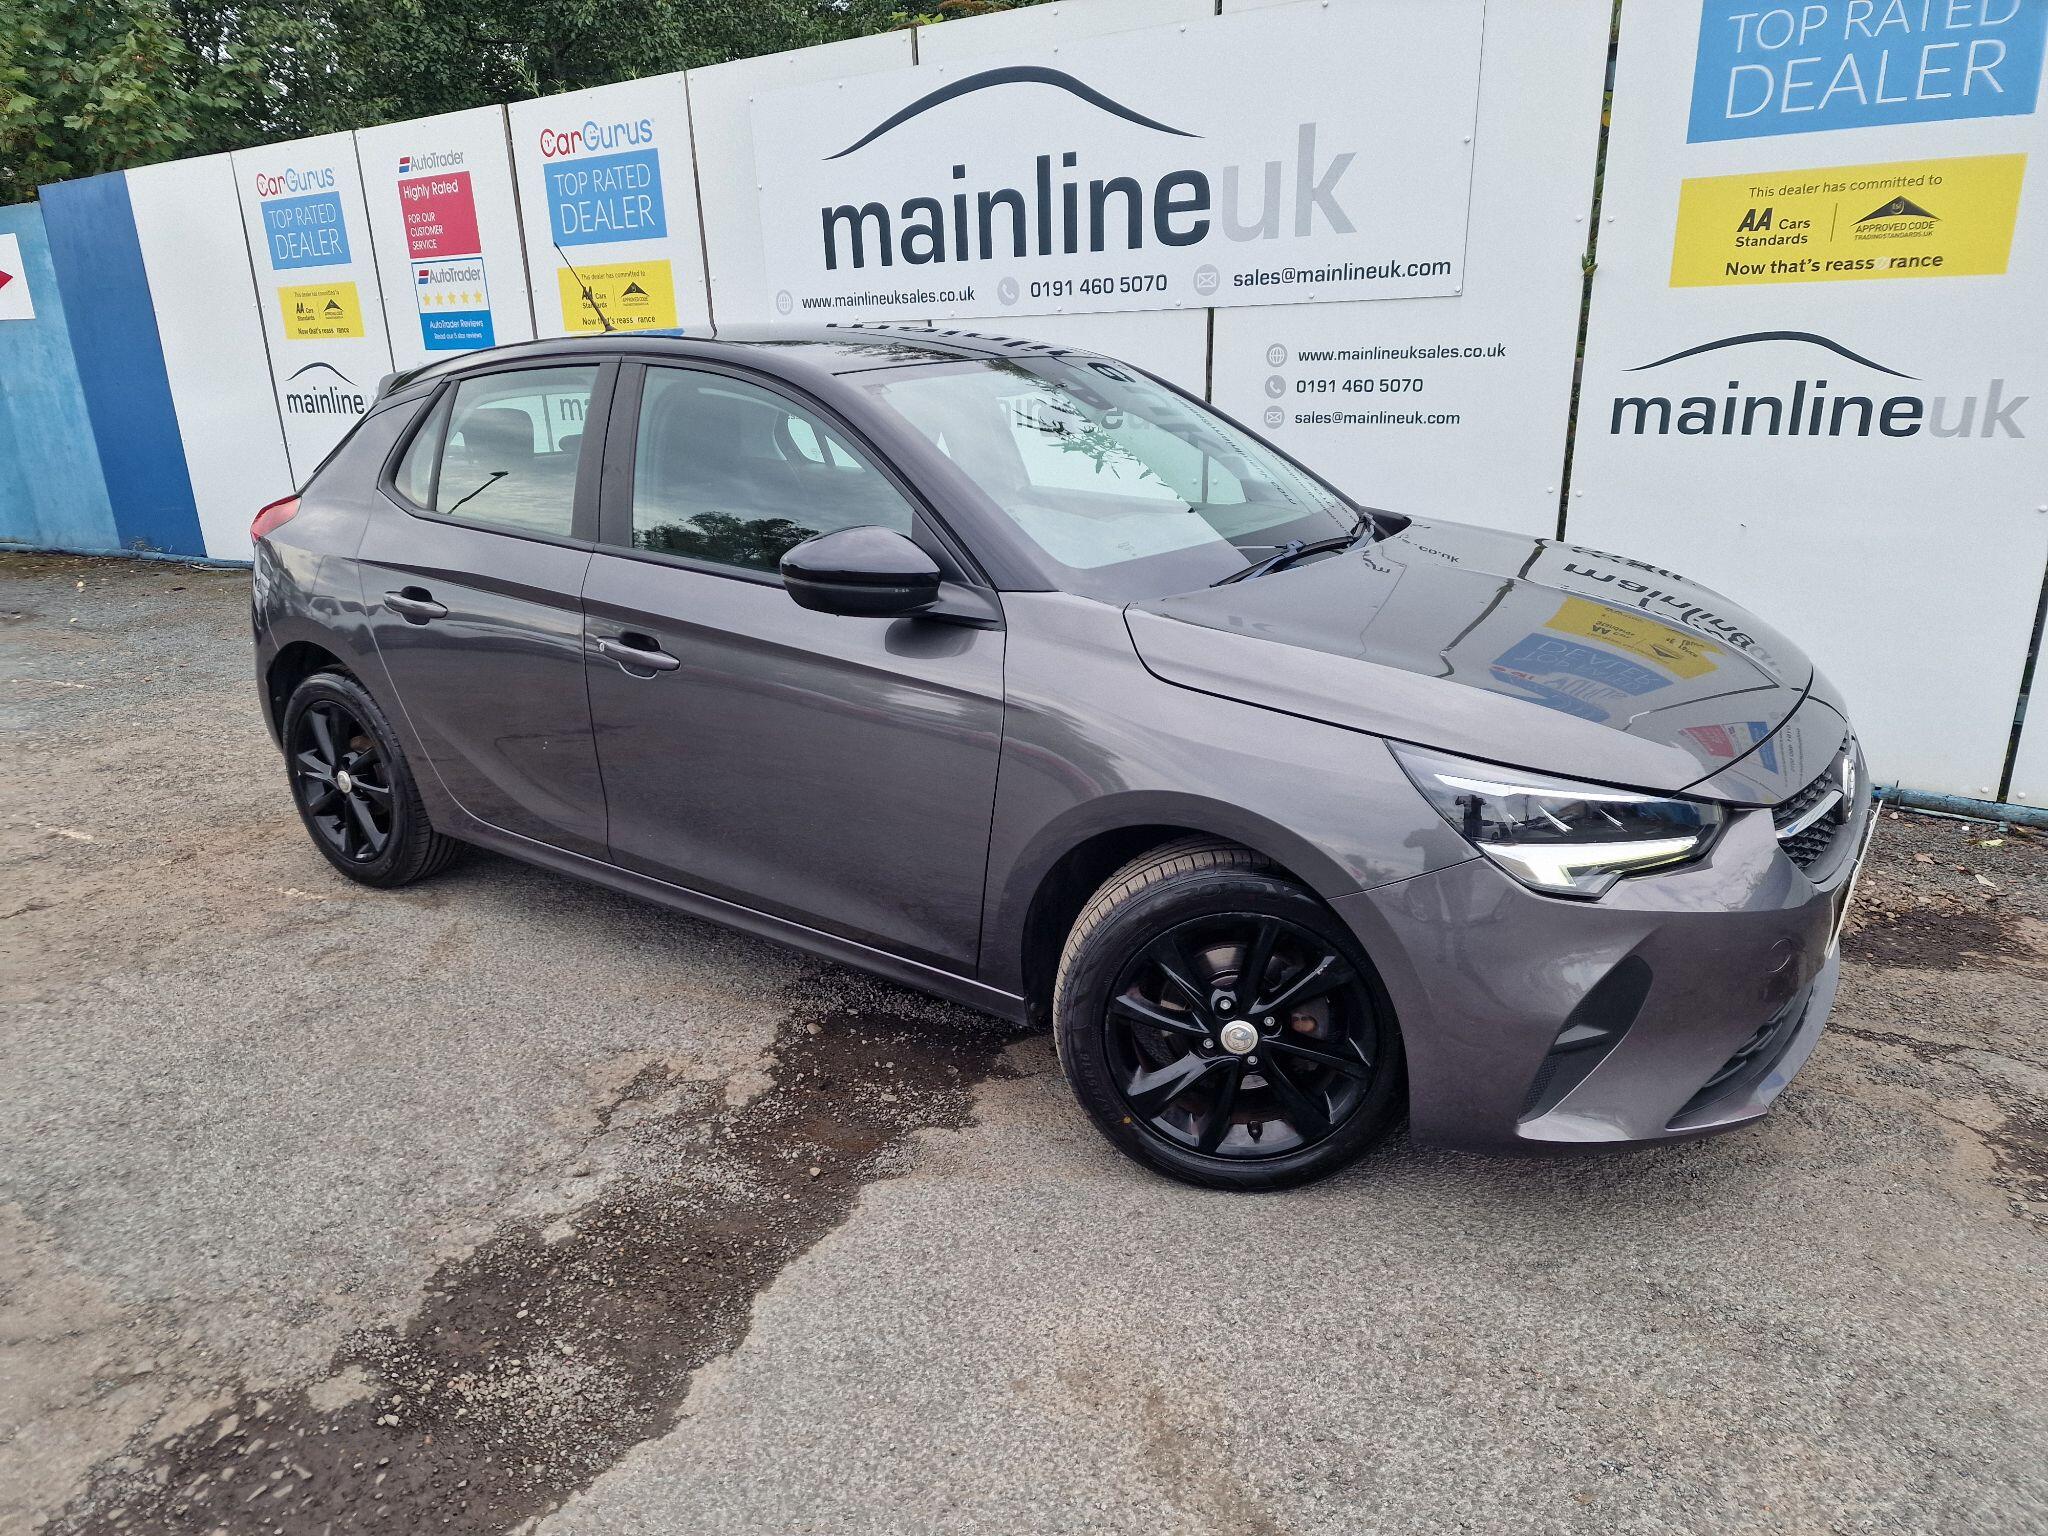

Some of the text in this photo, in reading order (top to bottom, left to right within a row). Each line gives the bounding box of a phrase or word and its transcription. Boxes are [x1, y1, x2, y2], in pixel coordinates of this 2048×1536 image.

[1728, 4, 1828, 53] TOP
[1725, 39, 2007, 119] DEALER
[540, 119, 653, 158] CarGurus
[410, 149, 464, 171] AutoTrader
[256, 167, 335, 197] CarGurus
[403, 179, 459, 201] Highly Rated
[553, 163, 651, 197] TOP RATED
[1749, 175, 1943, 198] This dealer has committed to
[821, 122, 1357, 271] mainlineuk
[268, 203, 336, 229] TOP RATED
[407, 212, 436, 224] FOR OUR
[560, 194, 655, 234] DEALER
[1736, 207, 1811, 233] AA Cars
[410, 225, 444, 237] CUSTOMER
[1855, 220, 1935, 233] APPROVED CODE
[275, 228, 343, 260] DEALER
[412, 239, 437, 251] SERVICE
[1735, 233, 1808, 247] Standards
[429, 266, 481, 284] AutoTrader
[1233, 260, 1451, 287] sales@mainlineuk.com
[1725, 260, 1765, 277] Now
[1825, 254, 1944, 272] reassrance
[802, 286, 975, 309] www.mainlineuksales.co.uk
[1031, 274, 1168, 298] 0191 460 5070
[582, 317, 596, 326] Now
[1298, 343, 1506, 362] www.mainlineuksales.co.uk
[1296, 378, 1423, 393] 0191 460 5070
[1294, 410, 1461, 425] sales@mainlineuk.com
[1609, 378, 2031, 438] mainlineuk
